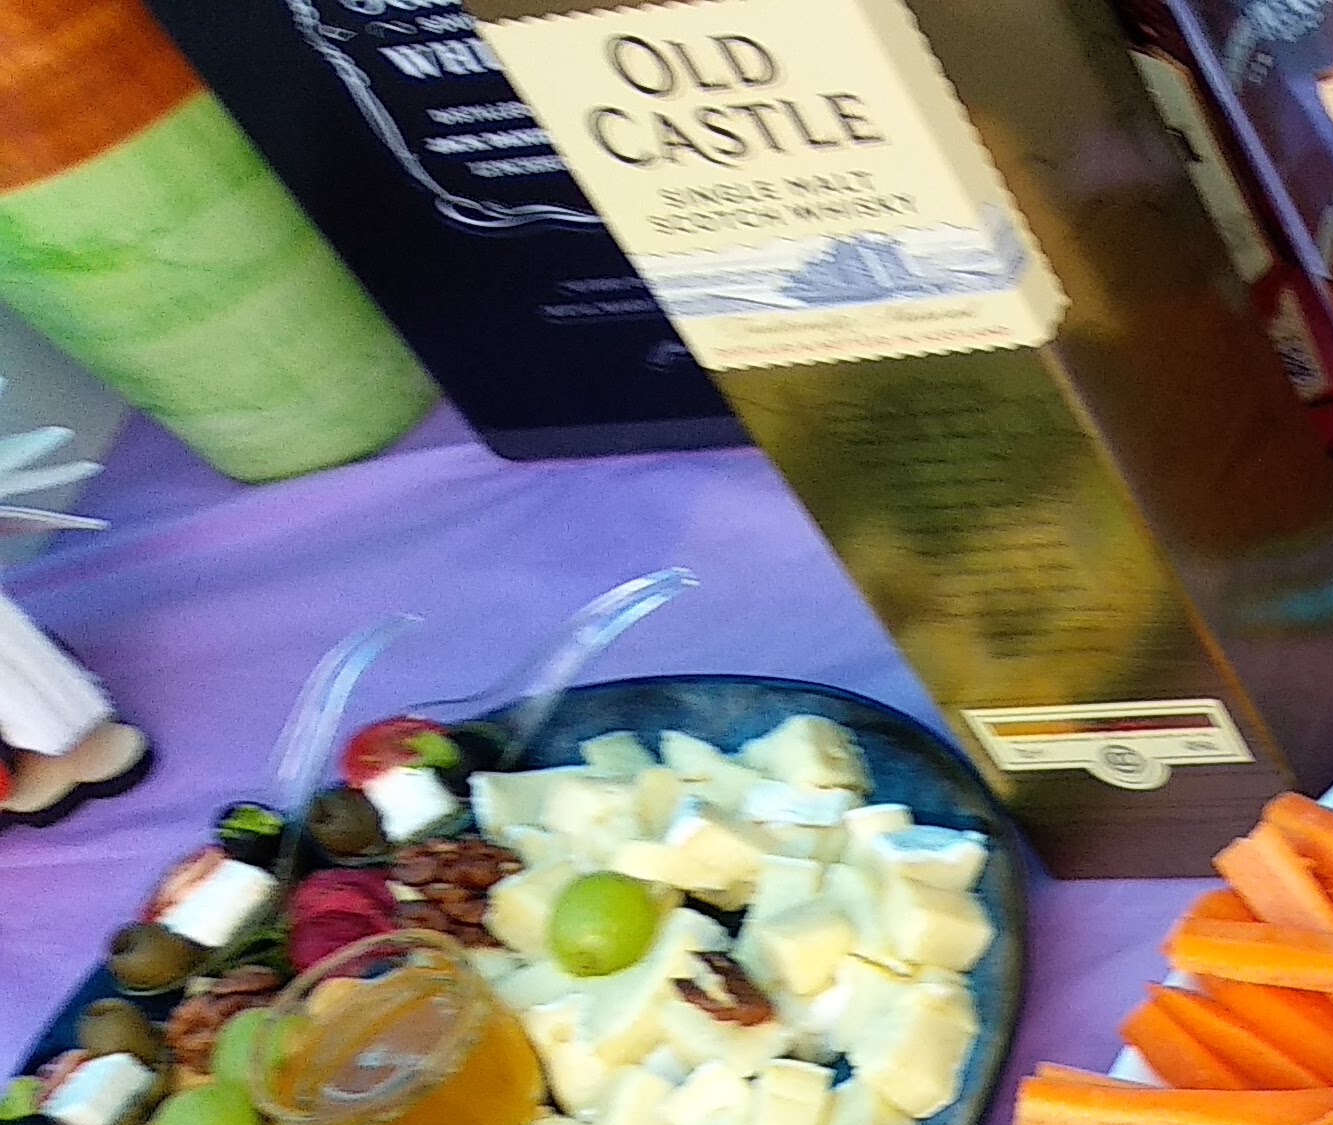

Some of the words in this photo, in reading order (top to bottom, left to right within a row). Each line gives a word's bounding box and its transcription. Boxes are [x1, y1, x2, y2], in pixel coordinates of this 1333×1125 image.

[604, 33, 780, 96] OLD
[587, 91, 886, 169] CASTLE
[646, 208, 788, 236] SCOTCH
[783, 193, 918, 223] WHISKY
[657, 180, 782, 210] SINGLE
[782, 170, 876, 199] MALT
